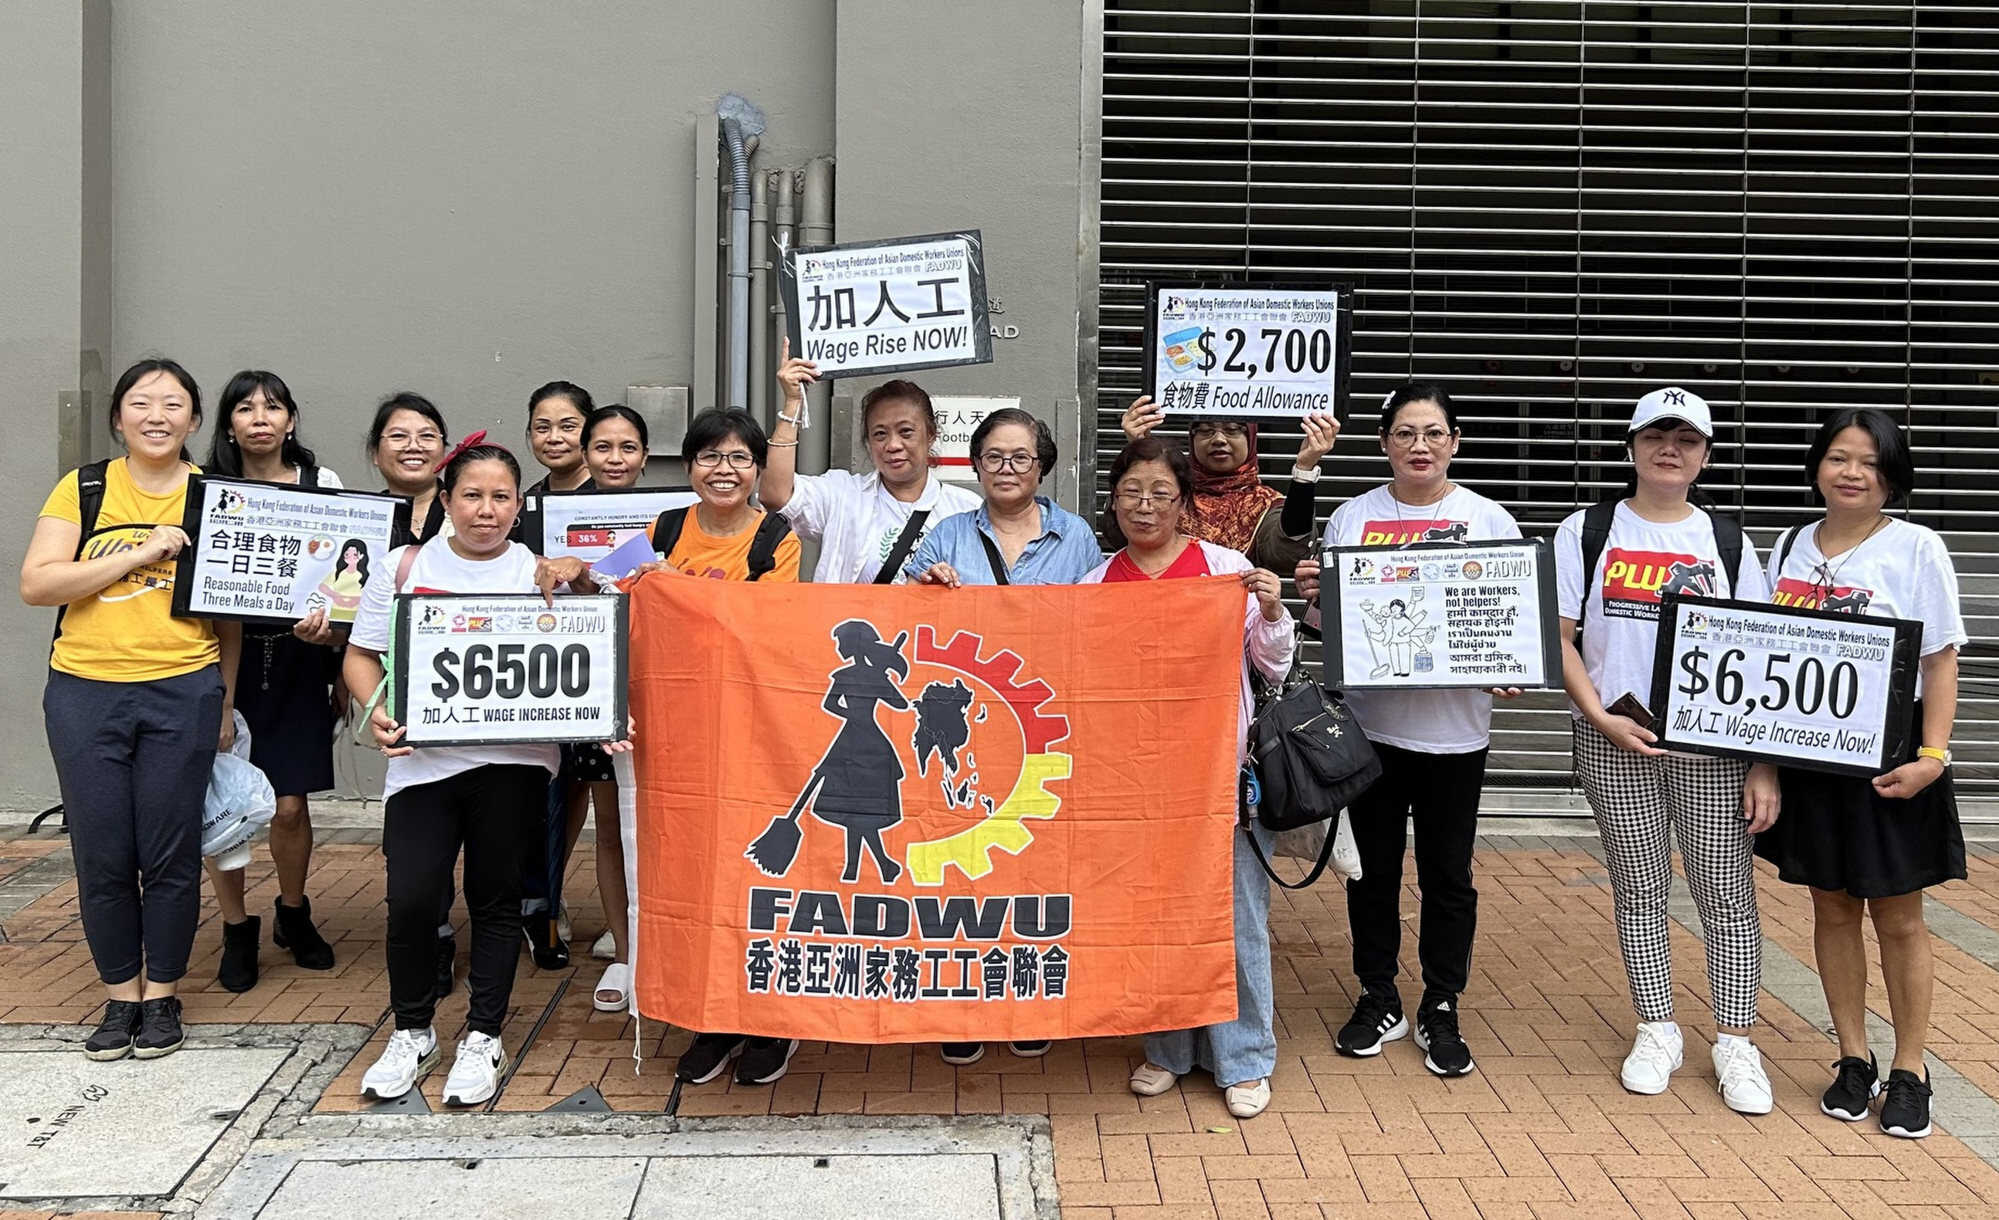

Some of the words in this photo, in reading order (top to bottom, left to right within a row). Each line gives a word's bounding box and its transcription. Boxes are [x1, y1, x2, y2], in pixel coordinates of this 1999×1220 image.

[836, 258, 849, 270] Kong
[850, 256, 877, 267] Federation
[878, 254, 884, 264] of
[885, 253, 899, 264] Asian
[900, 251, 923, 262] Domestic
[924, 249, 945, 260] Workers
[946, 247, 964, 258] Unions
[807, 277, 965, 332] 加人工
[1185, 298, 1198, 311] Hong
[1199, 298, 1213, 311] Kong
[1214, 297, 1242, 309] Federation
[1243, 298, 1249, 309] of
[1250, 298, 1265, 309] Asian
[1266, 298, 1291, 309] Domestic
[1292, 298, 1314, 310] Workers
[1315, 299, 1334, 310] Unions
[807, 338, 860, 363] Wage
[865, 333, 907, 356] Rise
[913, 326, 968, 352] NOW!
[1197, 326, 1331, 380] $2,700
[1161, 381, 1209, 409] 食物費
[1212, 385, 1251, 408] Food
[1252, 386, 1328, 410] Allowance
[262, 498, 275, 512] Kong
[276, 500, 303, 513] Federation
[310, 504, 324, 515] Asian
[325, 505, 347, 517] Domestic
[349, 508, 369, 519] Workers
[210, 529, 302, 556] 合理食物
[554, 535, 571, 544] YES
[578, 534, 597, 543] 36%
[206, 554, 299, 579] 一日三餐
[1486, 560, 1531, 578] FADWU
[1604, 561, 1666, 591] PLU
[204, 576, 263, 594] Reasonable
[265, 581, 290, 596] Food
[1445, 587, 1459, 597] We
[1461, 587, 1476, 596] are
[202, 591, 231, 607] Three
[233, 594, 264, 610] Meals
[267, 600, 272, 609] a
[275, 598, 295, 613] Day
[1446, 598, 1460, 607] not
[1463, 597, 1500, 608] helpers!
[561, 616, 607, 632] FADWU
[1709, 615, 1724, 631] Hong
[1726, 617, 1742, 633] Kong
[1744, 619, 1777, 635] Federation
[1778, 622, 1786, 635] of
[1786, 624, 1805, 637] Asian
[1806, 626, 1837, 641] Domestic
[1838, 629, 1865, 644] Workers
[1867, 632, 1890, 647] Unions
[1836, 643, 1885, 661] FADWU
[431, 643, 590, 703] $6500
[1678, 646, 1859, 719] $6,500
[422, 706, 480, 724] 加人工
[484, 708, 515, 722] WAGE
[519, 707, 571, 721] INCREASE
[575, 706, 600, 720] NOW
[1673, 704, 1722, 734] 加人工
[1725, 714, 1766, 745] Wage
[1769, 720, 1830, 749] Increase
[1833, 729, 1877, 755] Now!
[750, 887, 1071, 940] FADWU
[747, 938, 1069, 1000] 香港亞洲家務工工會聯會
[50, 1105, 85, 1126] NEW
